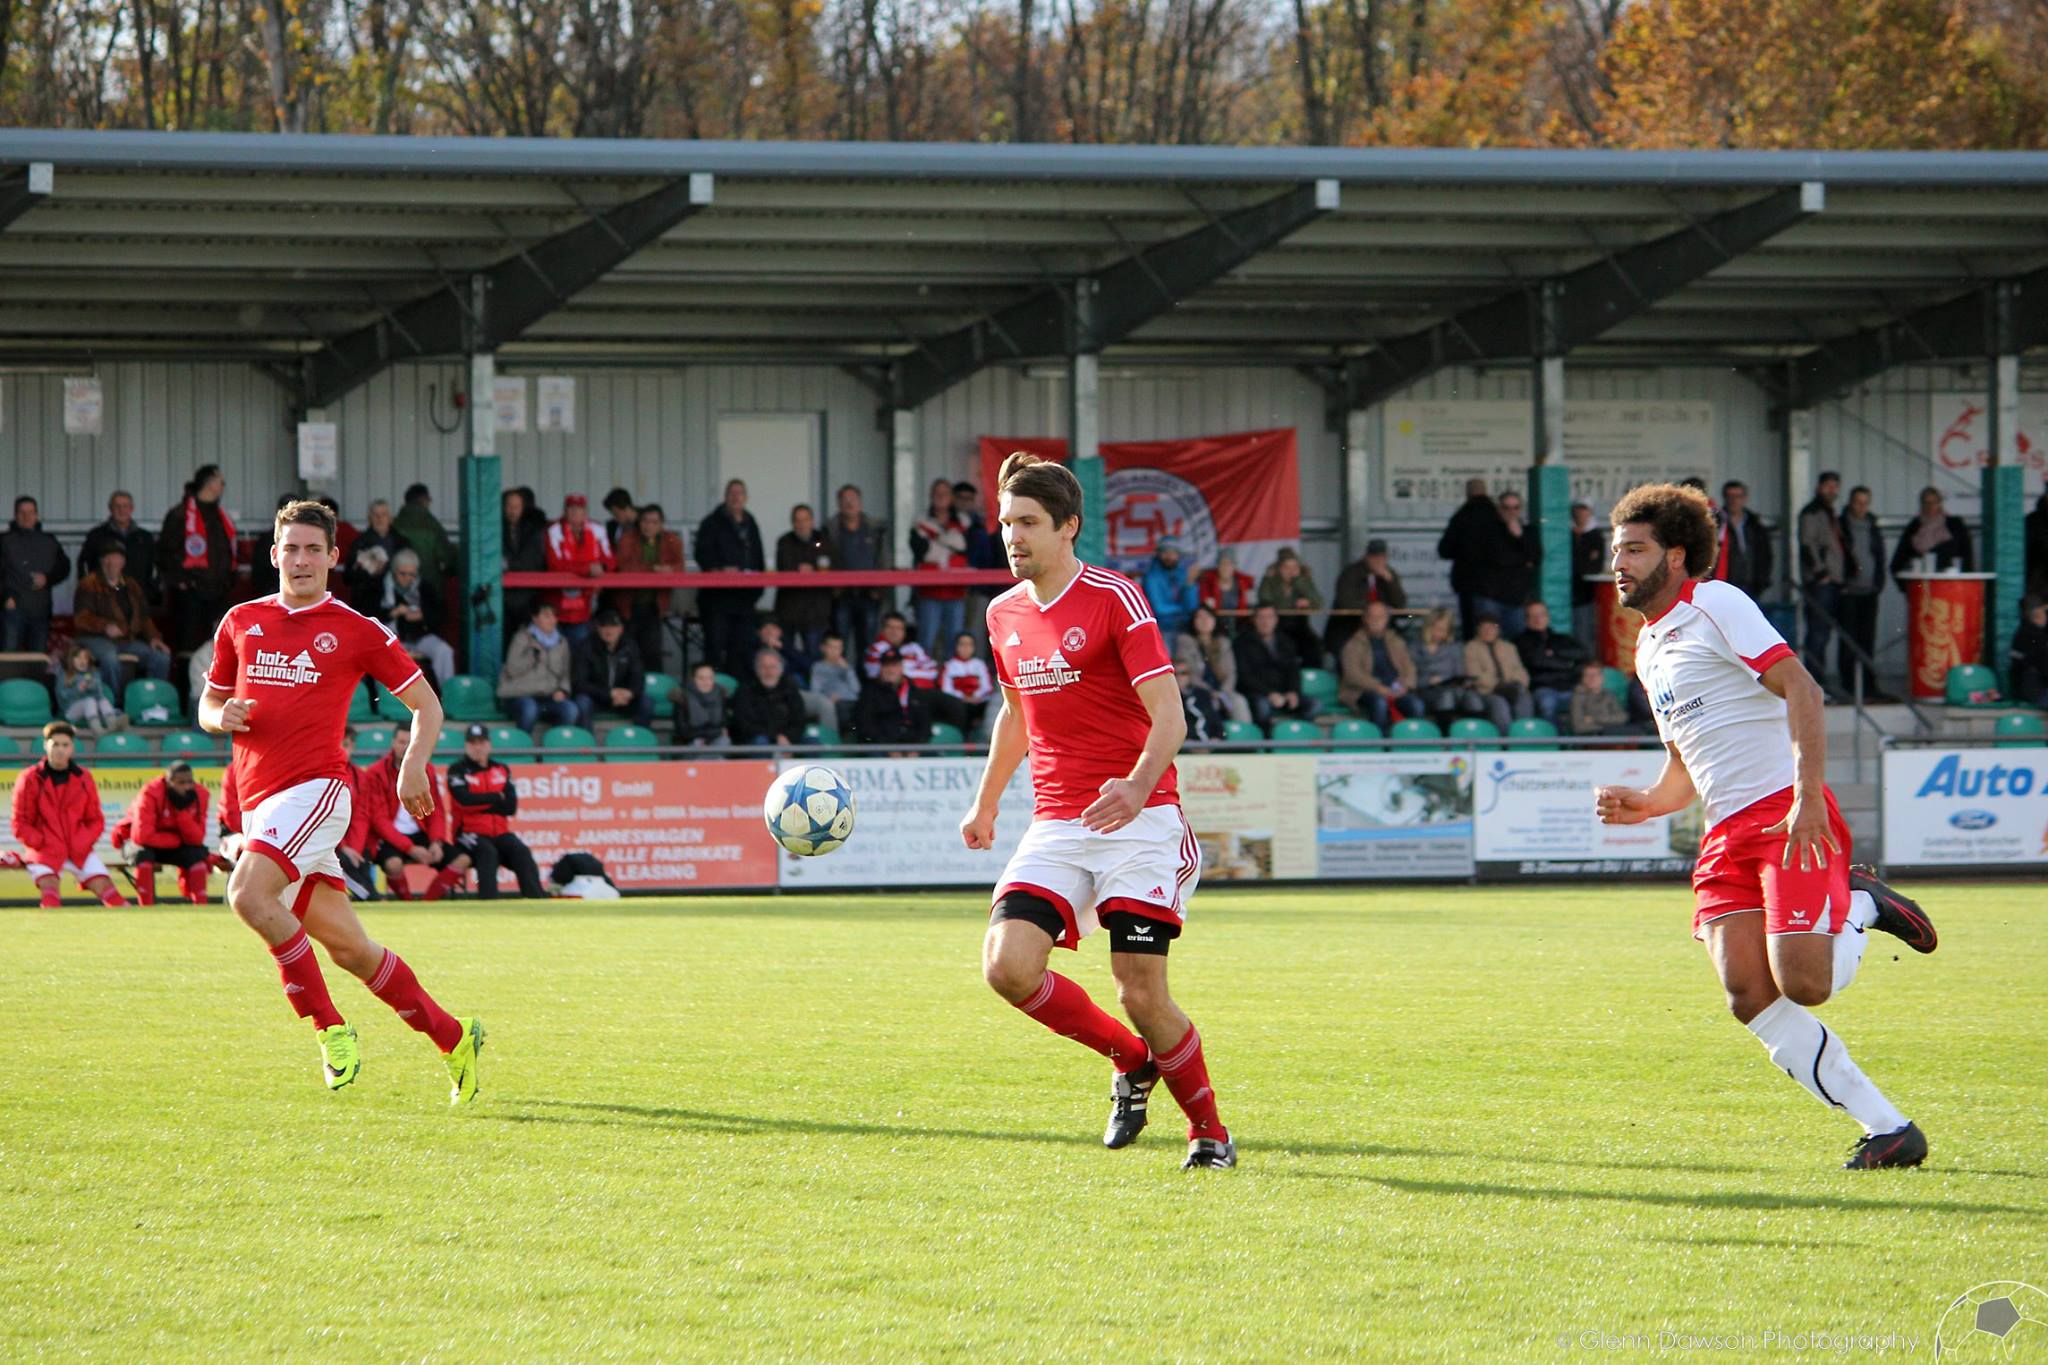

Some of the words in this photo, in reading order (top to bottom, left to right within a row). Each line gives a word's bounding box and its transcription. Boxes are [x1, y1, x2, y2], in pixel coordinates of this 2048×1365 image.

[255, 649, 290, 667] holz
[1018, 656, 1046, 674] holz
[1915, 753, 2035, 798] Auto
[514, 770, 602, 804] asing
[615, 863, 697, 881] LEASING
